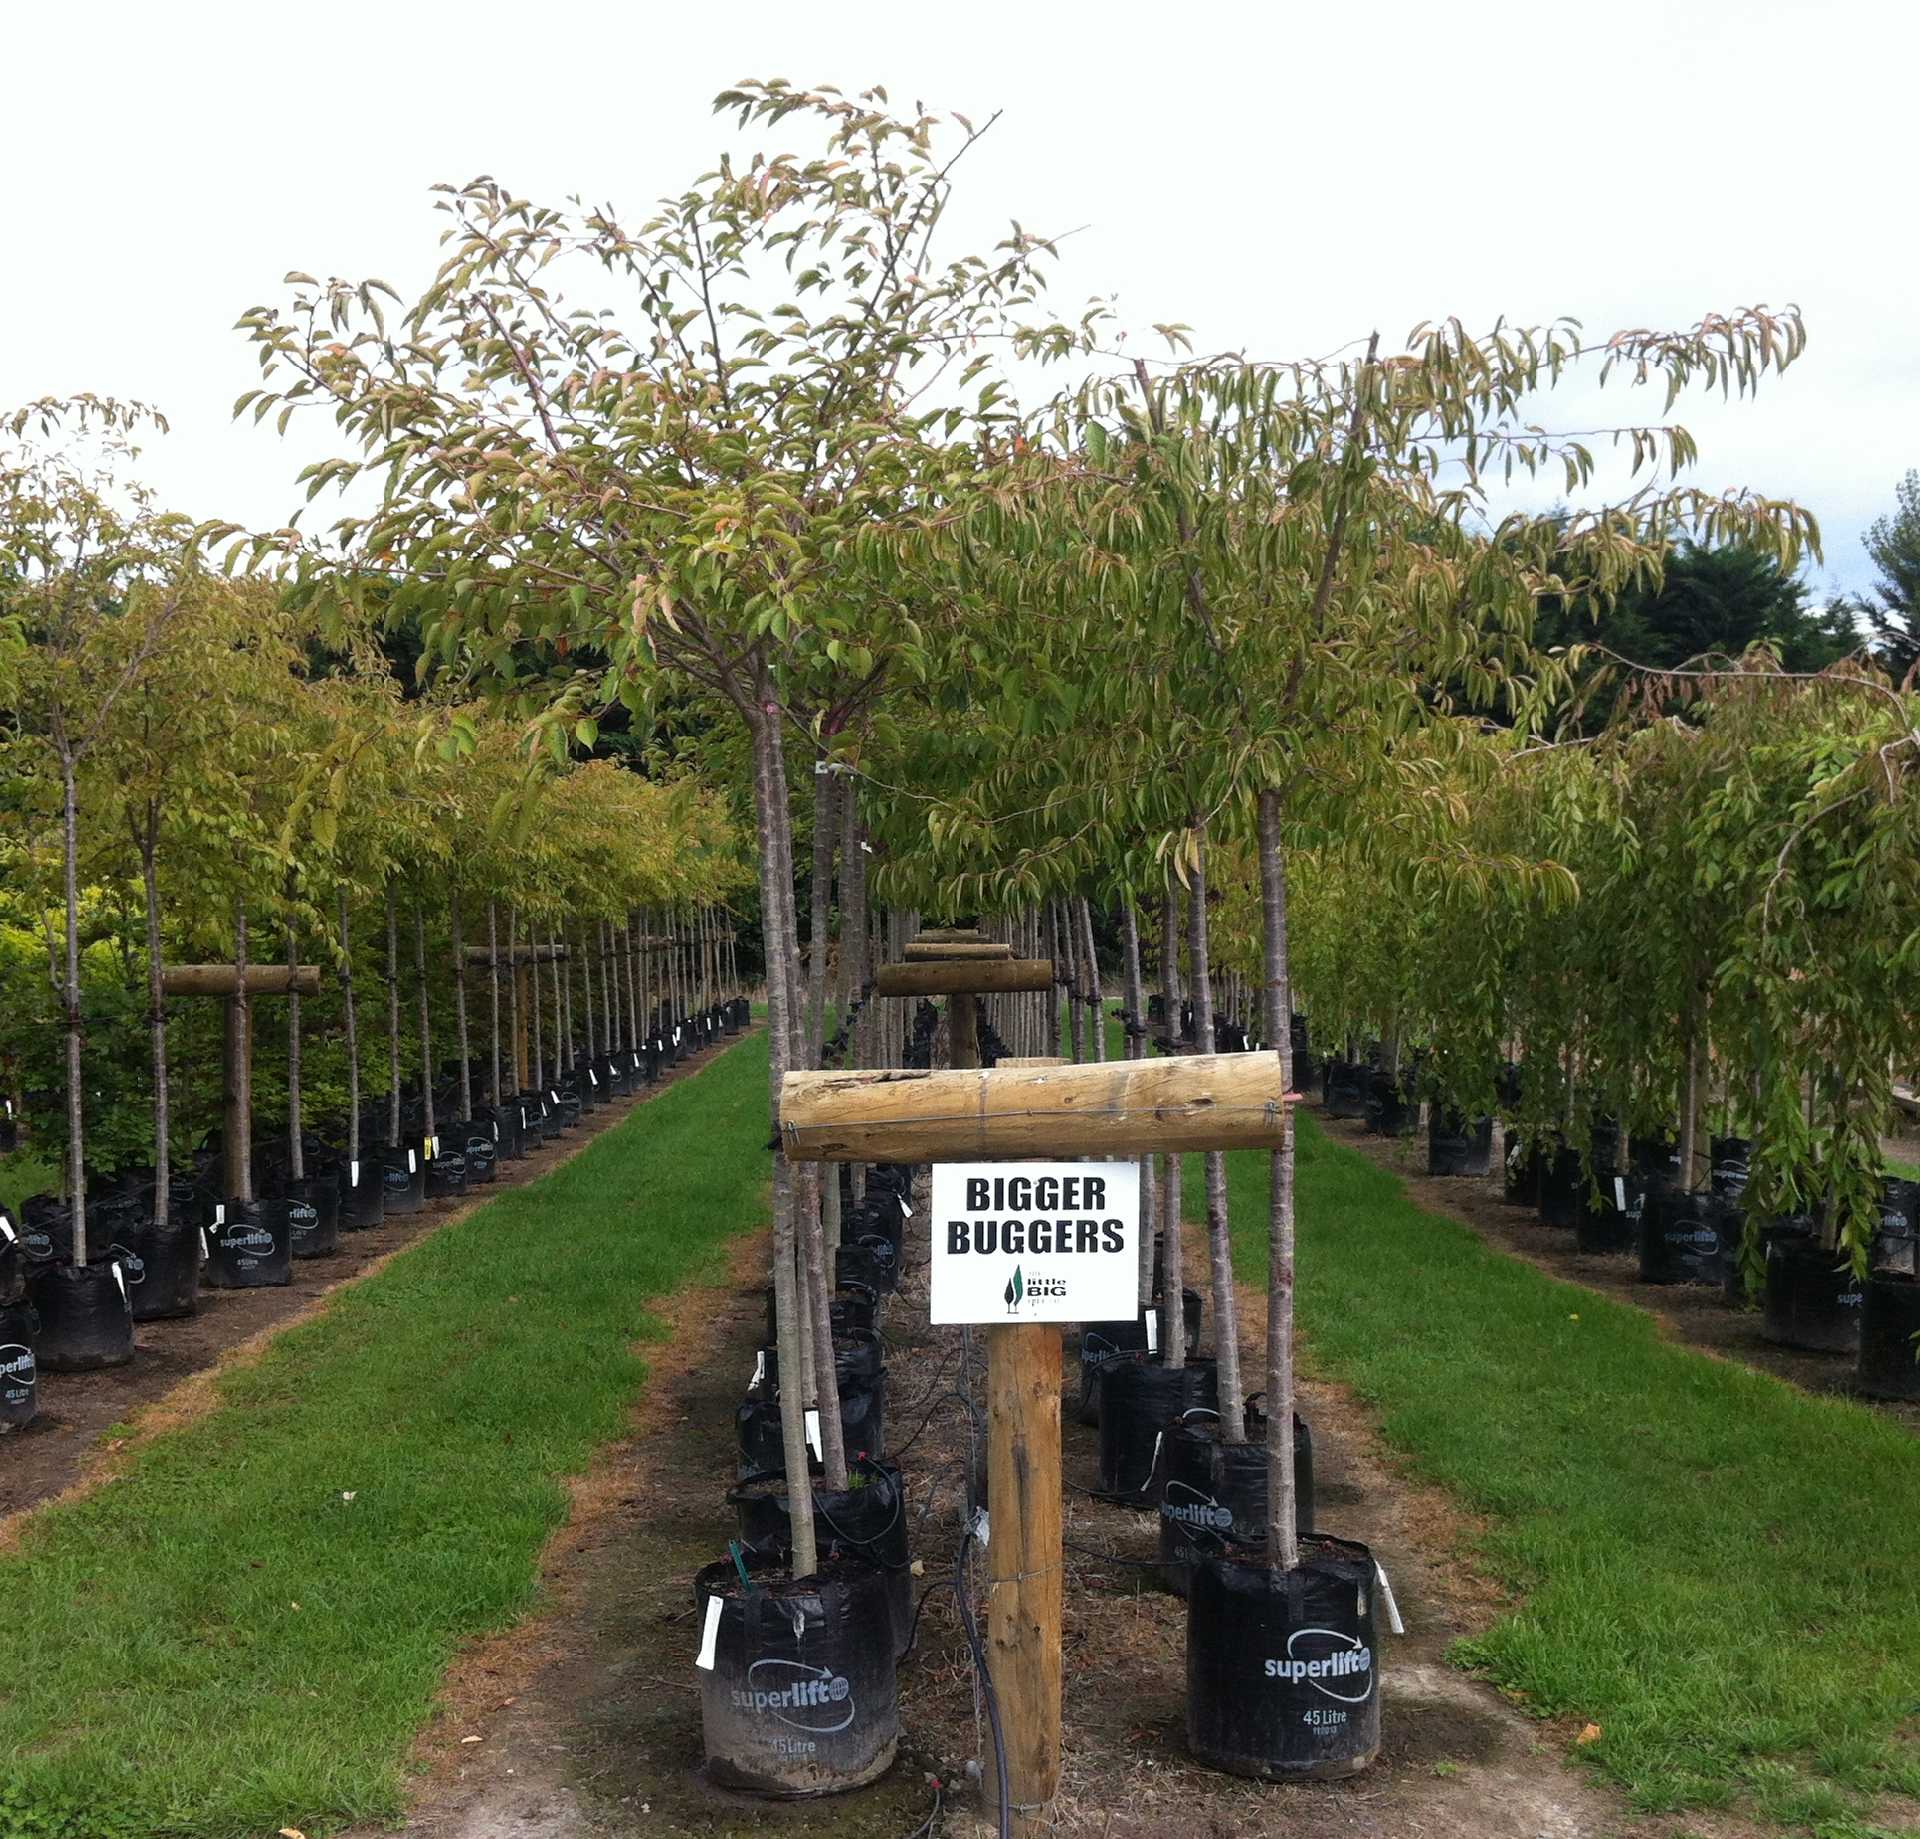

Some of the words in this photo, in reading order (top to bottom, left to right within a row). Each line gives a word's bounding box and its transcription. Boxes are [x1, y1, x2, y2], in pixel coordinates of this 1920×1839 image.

[966, 1177, 1106, 1211] BIGGER
[947, 1219, 1124, 1255] BUGGERS
[1027, 1278, 1066, 1286] little
[1027, 1286, 1067, 1297] BIG
[1265, 1650, 1359, 1684] superlift
[731, 1680, 829, 1714] superlift
[1303, 1710, 1321, 1725] 45
[1322, 1709, 1347, 1725] Litre
[788, 1737, 816, 1754] Litre
